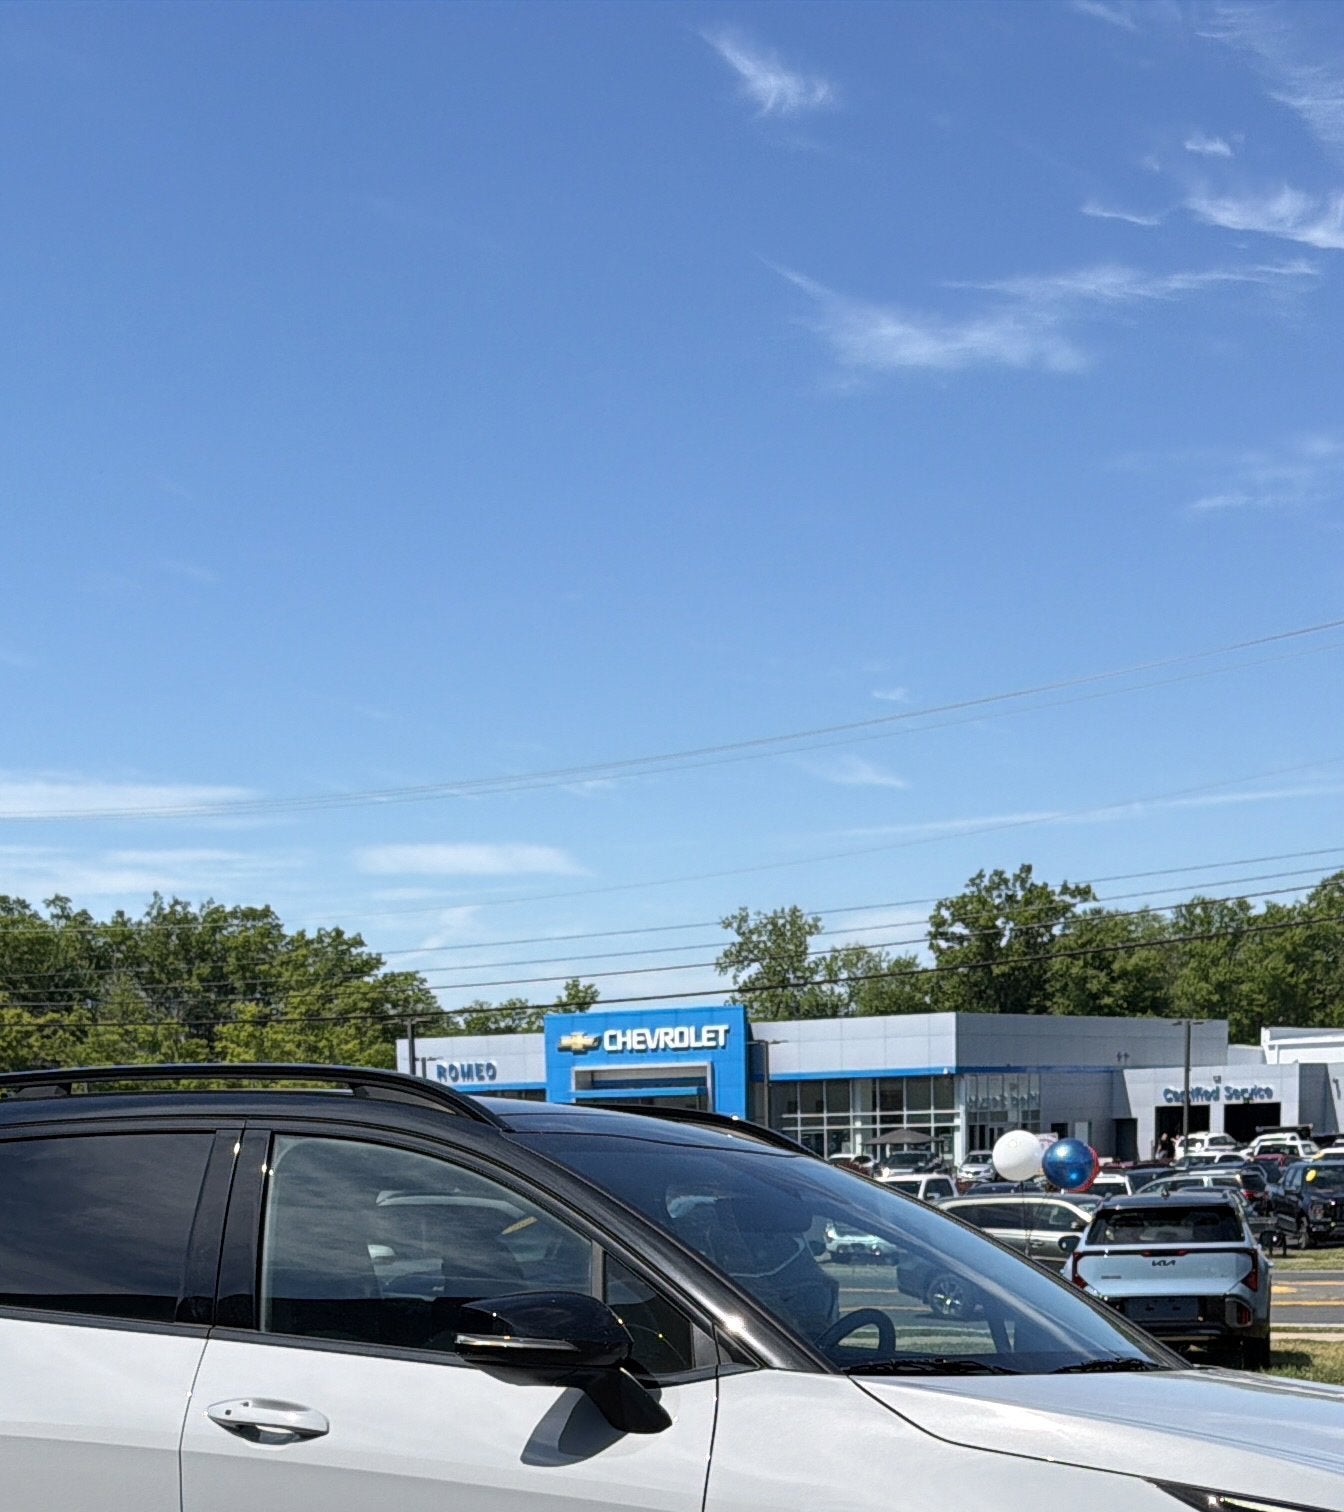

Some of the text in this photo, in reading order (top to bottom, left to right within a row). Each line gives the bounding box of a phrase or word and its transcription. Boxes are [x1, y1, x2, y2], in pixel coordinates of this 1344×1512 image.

[603, 1024, 730, 1052] CHEVROLET
[436, 1062, 497, 1083] ROMEO
[1163, 1084, 1273, 1103] Cerified Service
[1151, 1259, 1176, 1267] KIA
